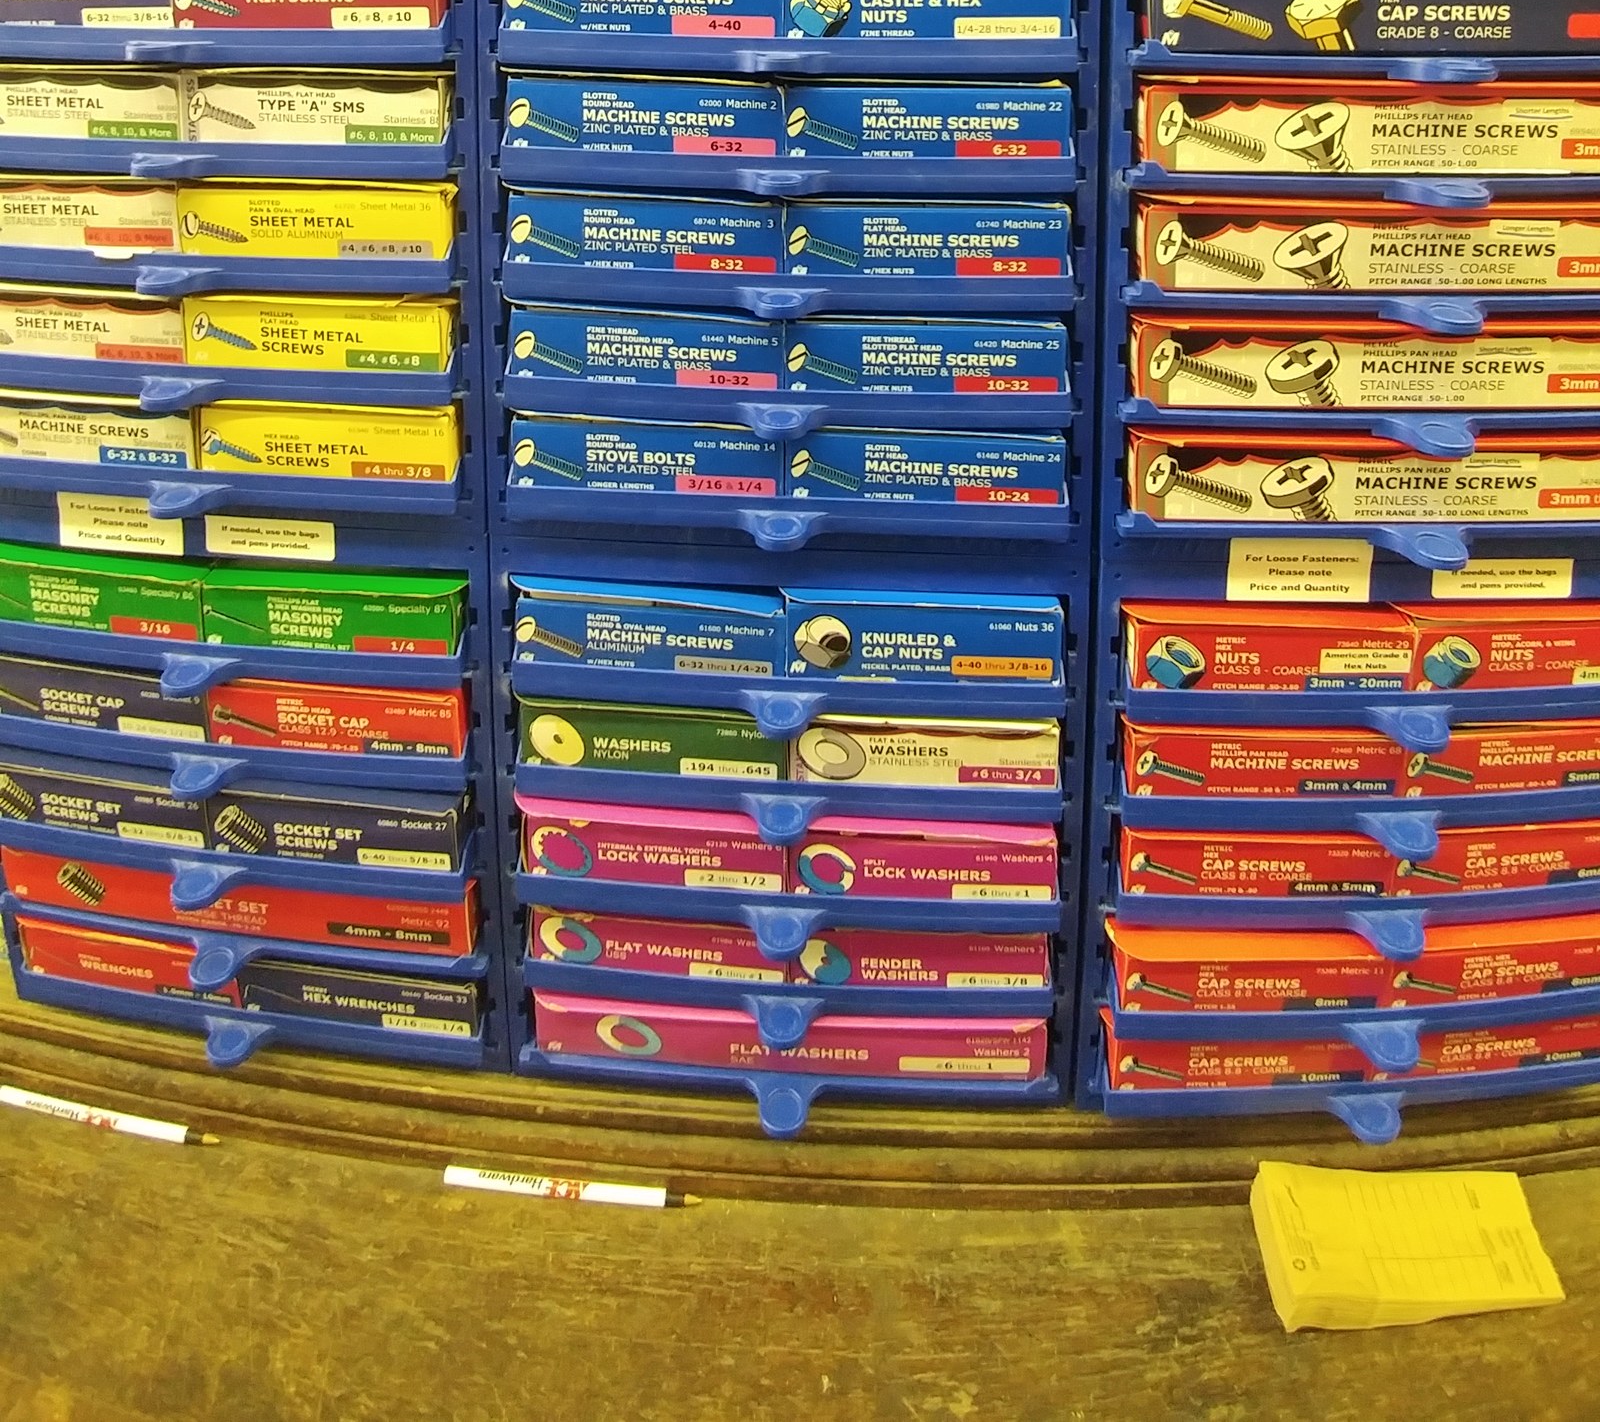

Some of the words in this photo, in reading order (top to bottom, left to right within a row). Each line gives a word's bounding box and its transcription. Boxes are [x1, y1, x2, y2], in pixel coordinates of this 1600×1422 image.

[860, 9, 907, 24] NUTS
[708, 19, 742, 32] 4-40
[258, 98, 296, 113] TYPE
[332, 100, 364, 114] SMS
[1003, 100, 1044, 113] Machine
[1048, 100, 1062, 113] 22
[1371, 123, 1468, 139] MACHINE
[1474, 124, 1558, 139] SCREWS
[709, 139, 743, 154] 6-32
[250, 215, 299, 228] SHEET
[304, 215, 354, 228] METAL
[250, 229, 282, 239] SOLID
[286, 229, 343, 239] ALUMINUM
[992, 259, 1027, 274] 8-32
[359, 354, 378, 366] #4,
[382, 354, 401, 367] #6,
[403, 355, 420, 367] #8
[708, 373, 749, 388] 10-32
[586, 449, 638, 466] STOVE
[643, 451, 696, 468] BOLTS
[1358, 466, 1402, 474] PHILLIPS
[1405, 466, 1423, 474] PAN
[1426, 466, 1451, 474] HEAD
[1355, 476, 1451, 491] MACHINE
[1455, 476, 1536, 491] SCREWS
[987, 489, 1030, 503] 10-24
[268, 610, 342, 629] MASONRY
[270, 623, 333, 639] SCREWS
[391, 641, 415, 653] 1/4
[861, 632, 938, 648] KNURLED
[943, 634, 956, 648] &
[862, 646, 895, 660] CAP
[901, 646, 943, 661] NUTS
[1215, 651, 1260, 665] NUTS
[955, 660, 981, 671] 4-40
[985, 661, 1005, 672] thru
[1008, 661, 1047, 673] 3/8-16
[278, 713, 335, 728] SOCKET
[339, 716, 369, 729] CAP
[869, 744, 949, 758] WASHERS
[1210, 756, 1286, 770] MACHINE
[1290, 758, 1360, 771] SCREWS
[273, 822, 330, 840] SOCKET
[334, 826, 363, 841] SET
[1202, 859, 1235, 872] CAP
[1238, 860, 1306, 873] SCREWS
[863, 866, 906, 881] LOCK
[911, 867, 991, 883] WASHERS
[861, 957, 922, 971] FENDER
[302, 992, 332, 1006] HEX
[335, 995, 415, 1015] WRENCHES
[1315, 996, 1348, 1008] 8mm
[478, 1169, 544, 1191] Hardware
